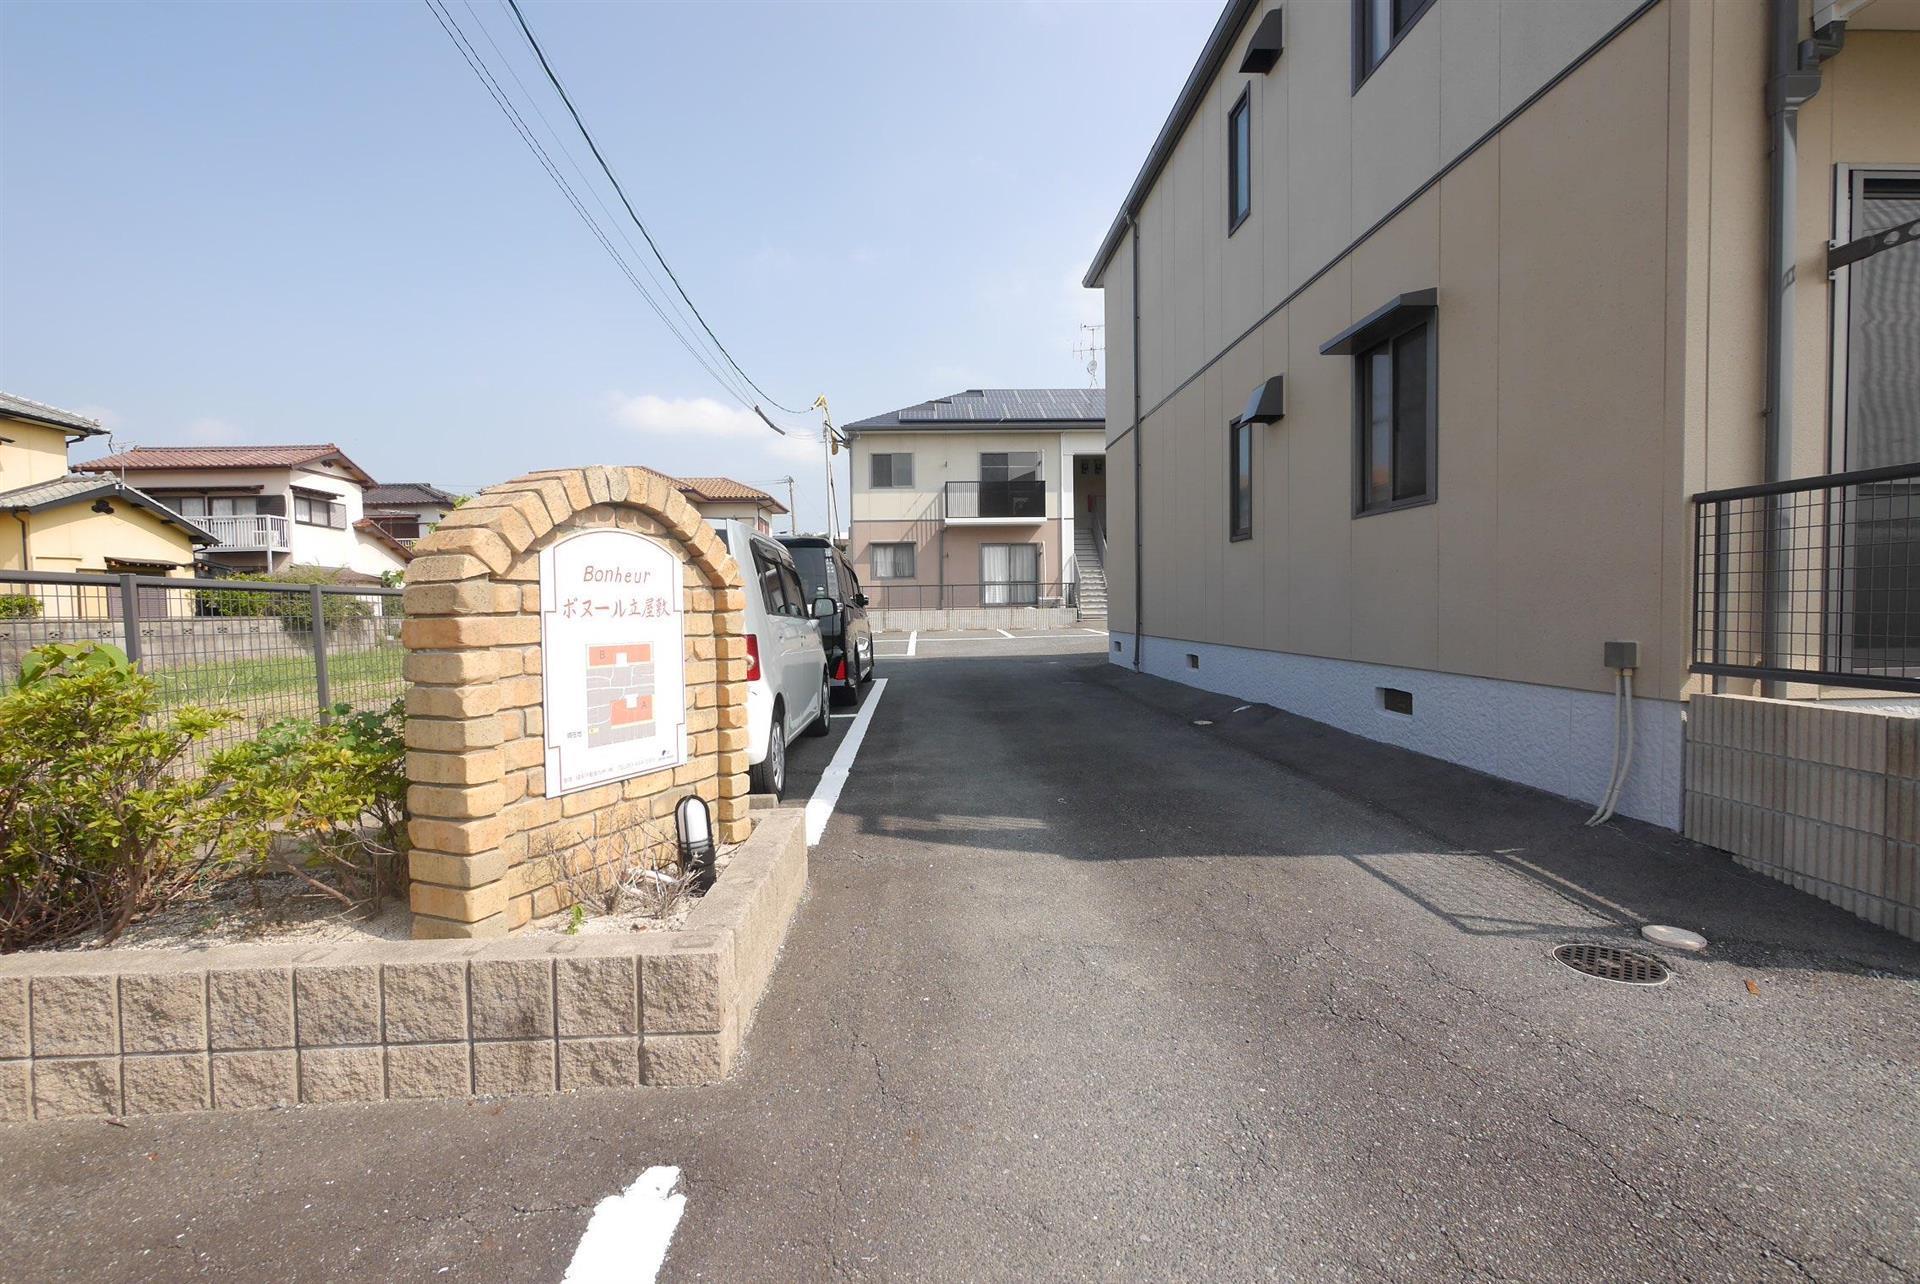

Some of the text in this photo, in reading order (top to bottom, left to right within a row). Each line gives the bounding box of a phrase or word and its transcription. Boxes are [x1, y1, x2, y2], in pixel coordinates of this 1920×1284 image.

[583, 565, 651, 584] Bonheur
[562, 597, 671, 618] ボヌール立屋敷
[599, 650, 606, 660] B
